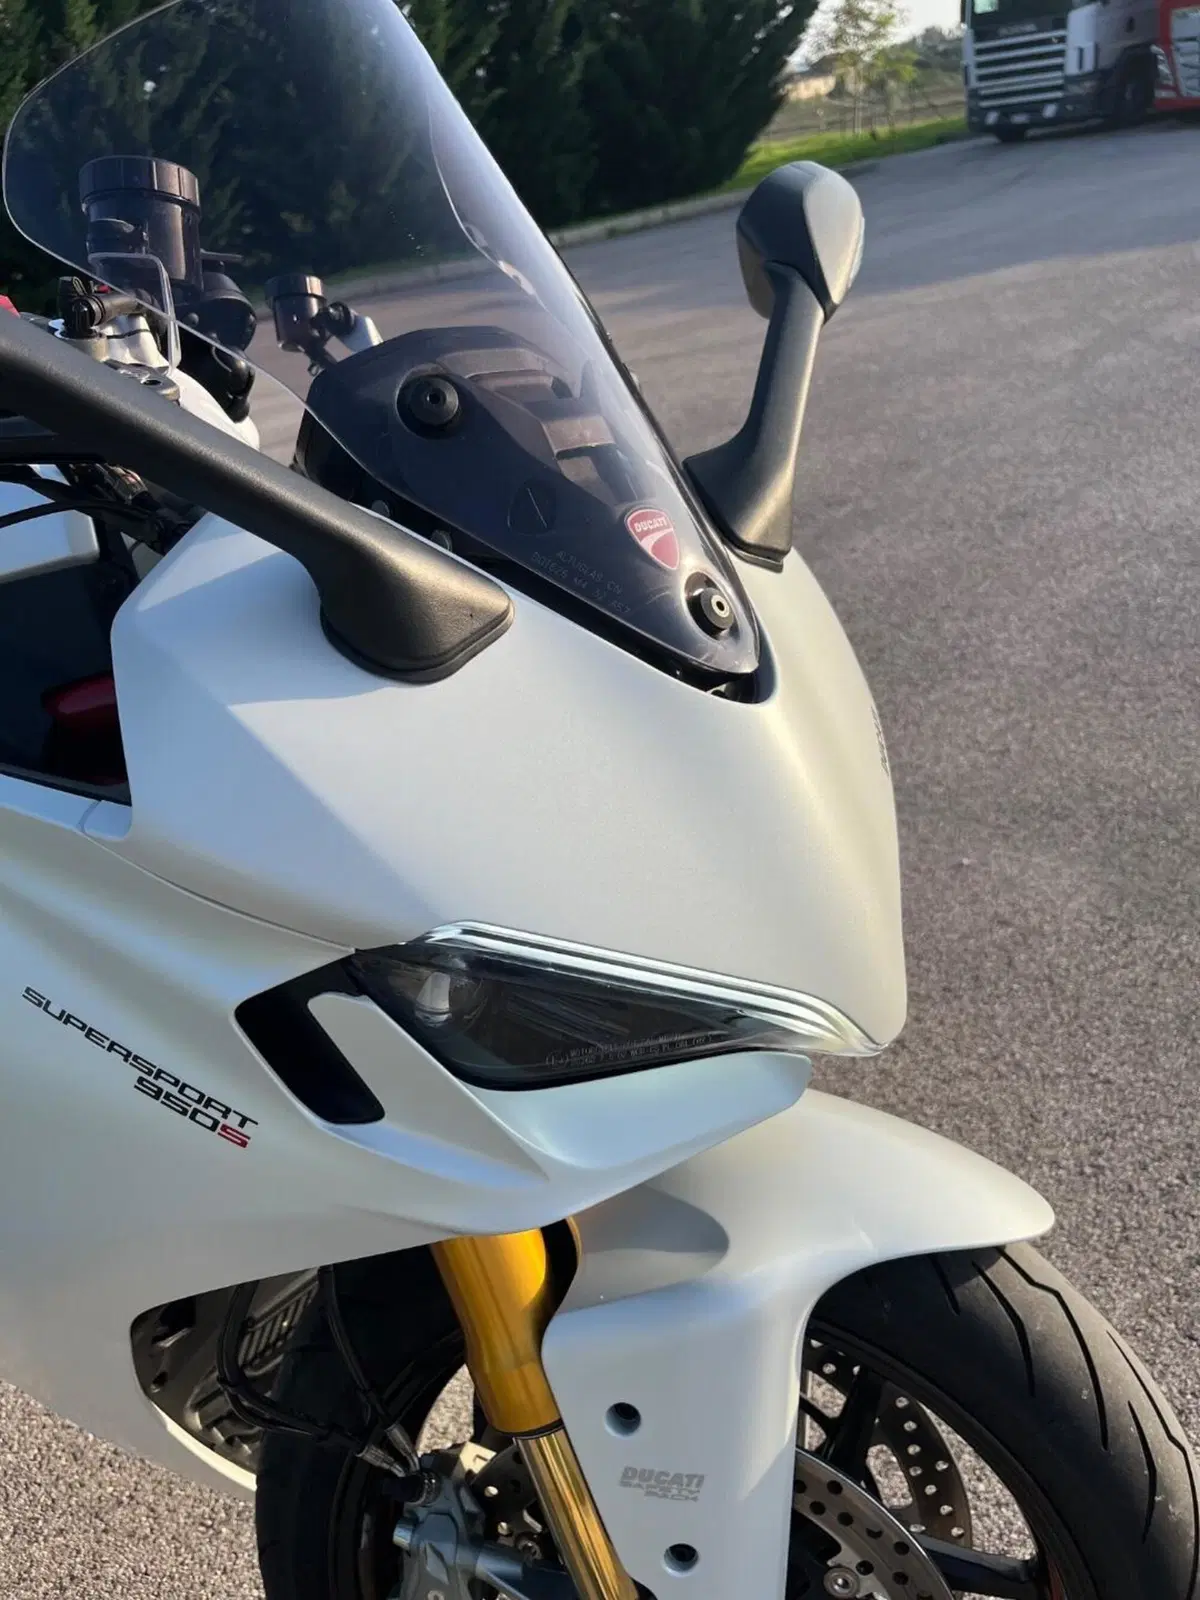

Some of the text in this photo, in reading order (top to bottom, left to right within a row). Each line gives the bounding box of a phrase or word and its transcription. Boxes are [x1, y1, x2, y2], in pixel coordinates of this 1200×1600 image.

[634, 516, 667, 532] DUCATI
[22, 986, 258, 1128] SUPERSPORT
[134, 1075, 251, 1148] 950S
[620, 1466, 705, 1490] DUCATI
